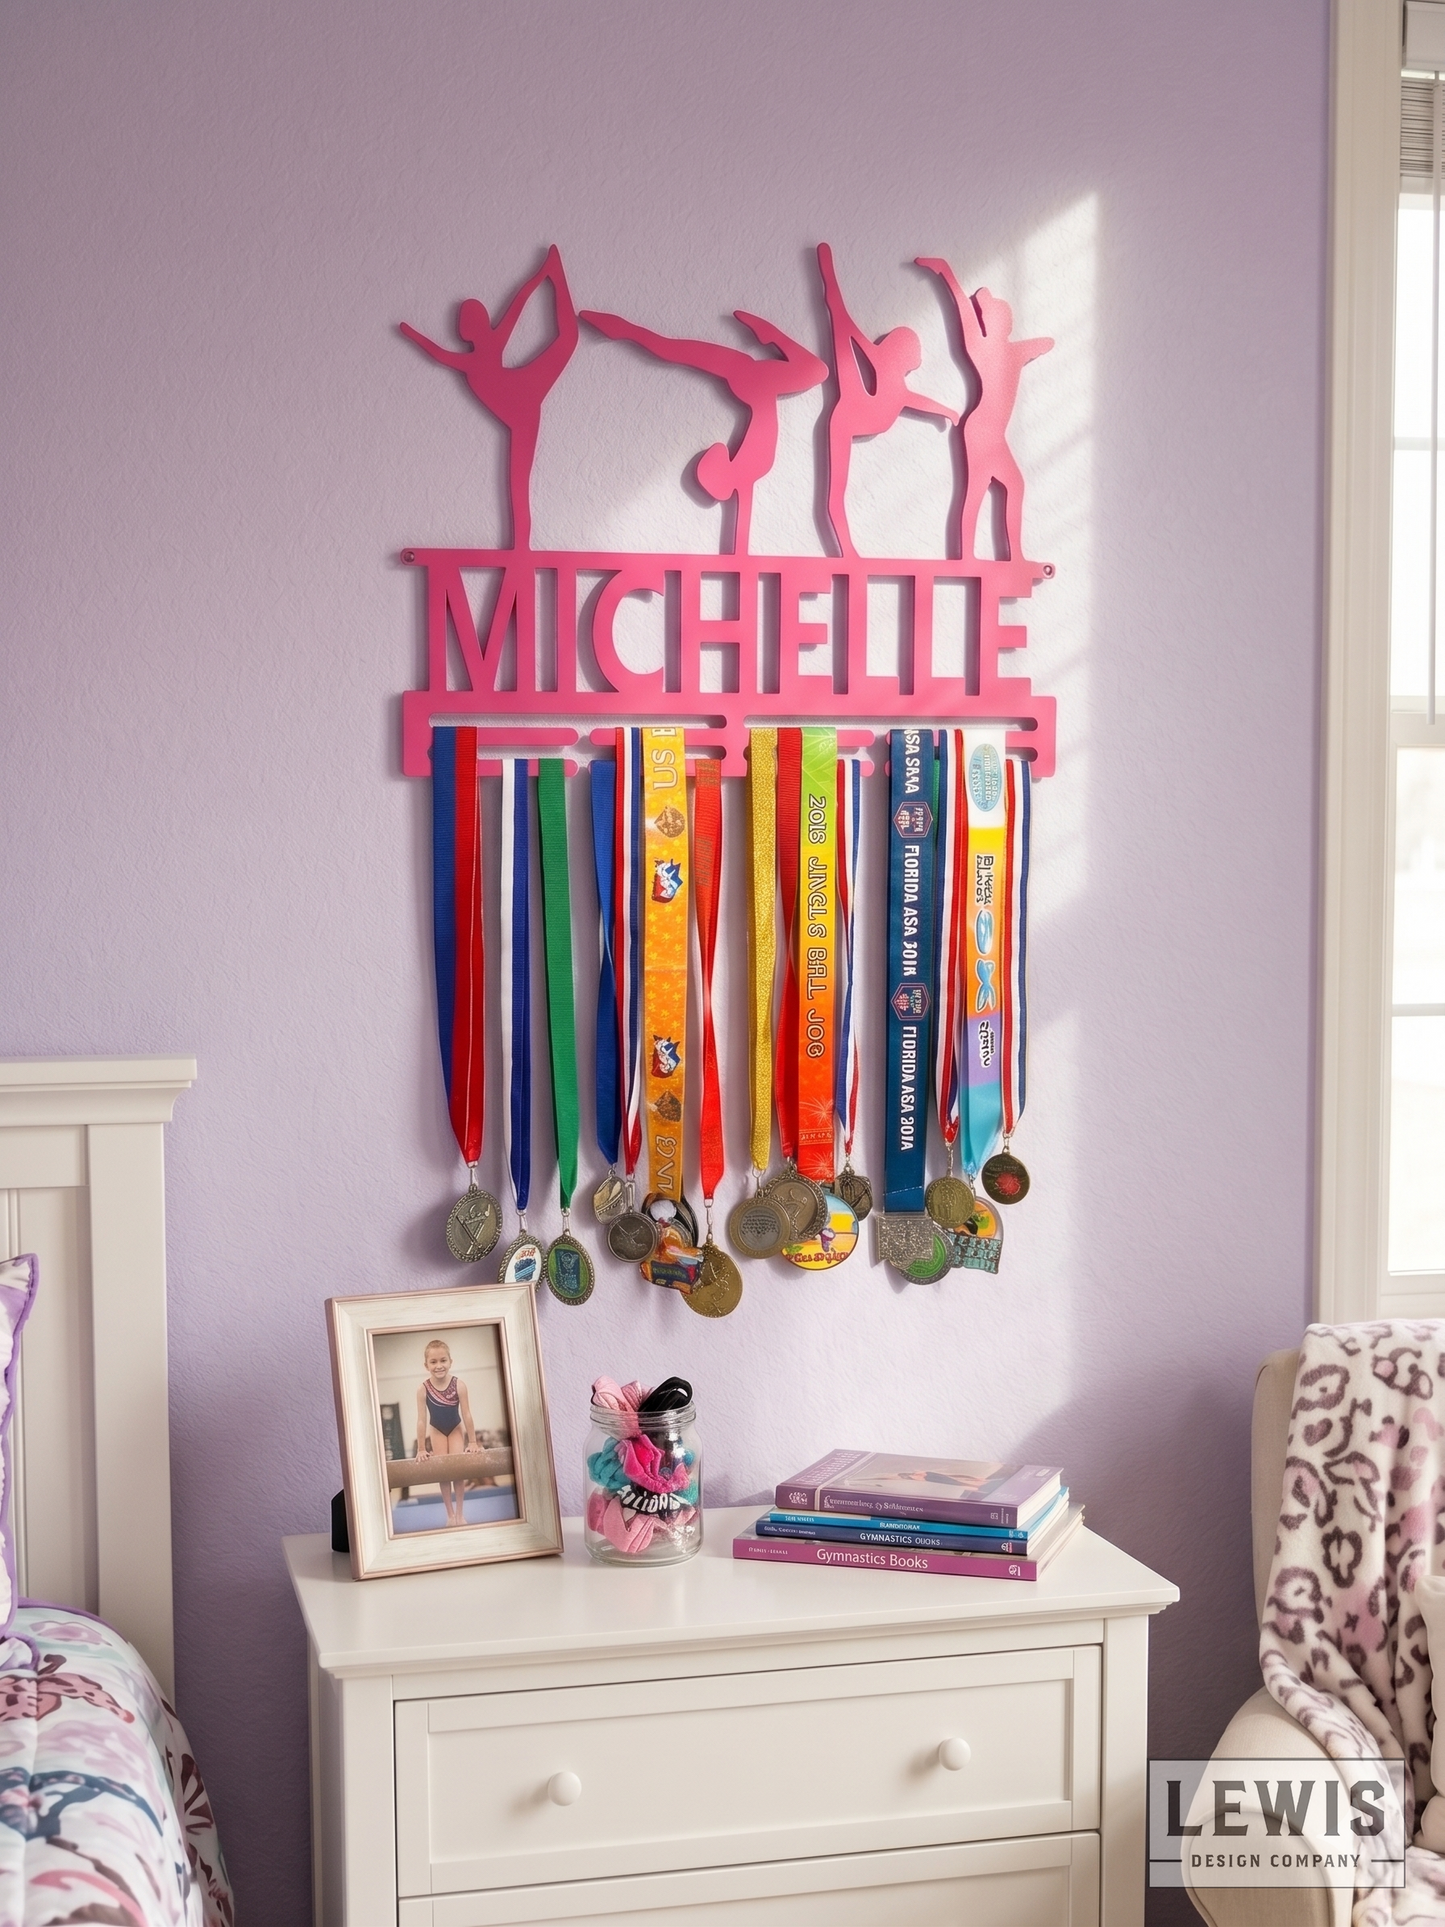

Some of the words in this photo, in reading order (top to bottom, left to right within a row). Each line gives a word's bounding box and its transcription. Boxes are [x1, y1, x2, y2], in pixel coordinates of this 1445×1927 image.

[427, 557, 1032, 697] MICHELLE
[904, 845, 920, 904] FLORIDA
[903, 906, 918, 937] ASA
[806, 1008, 825, 1059] JOG
[816, 1548, 886, 1565] Gymnastics
[889, 1553, 928, 1569] Books
[859, 1532, 912, 1544] GYMNASTICS
